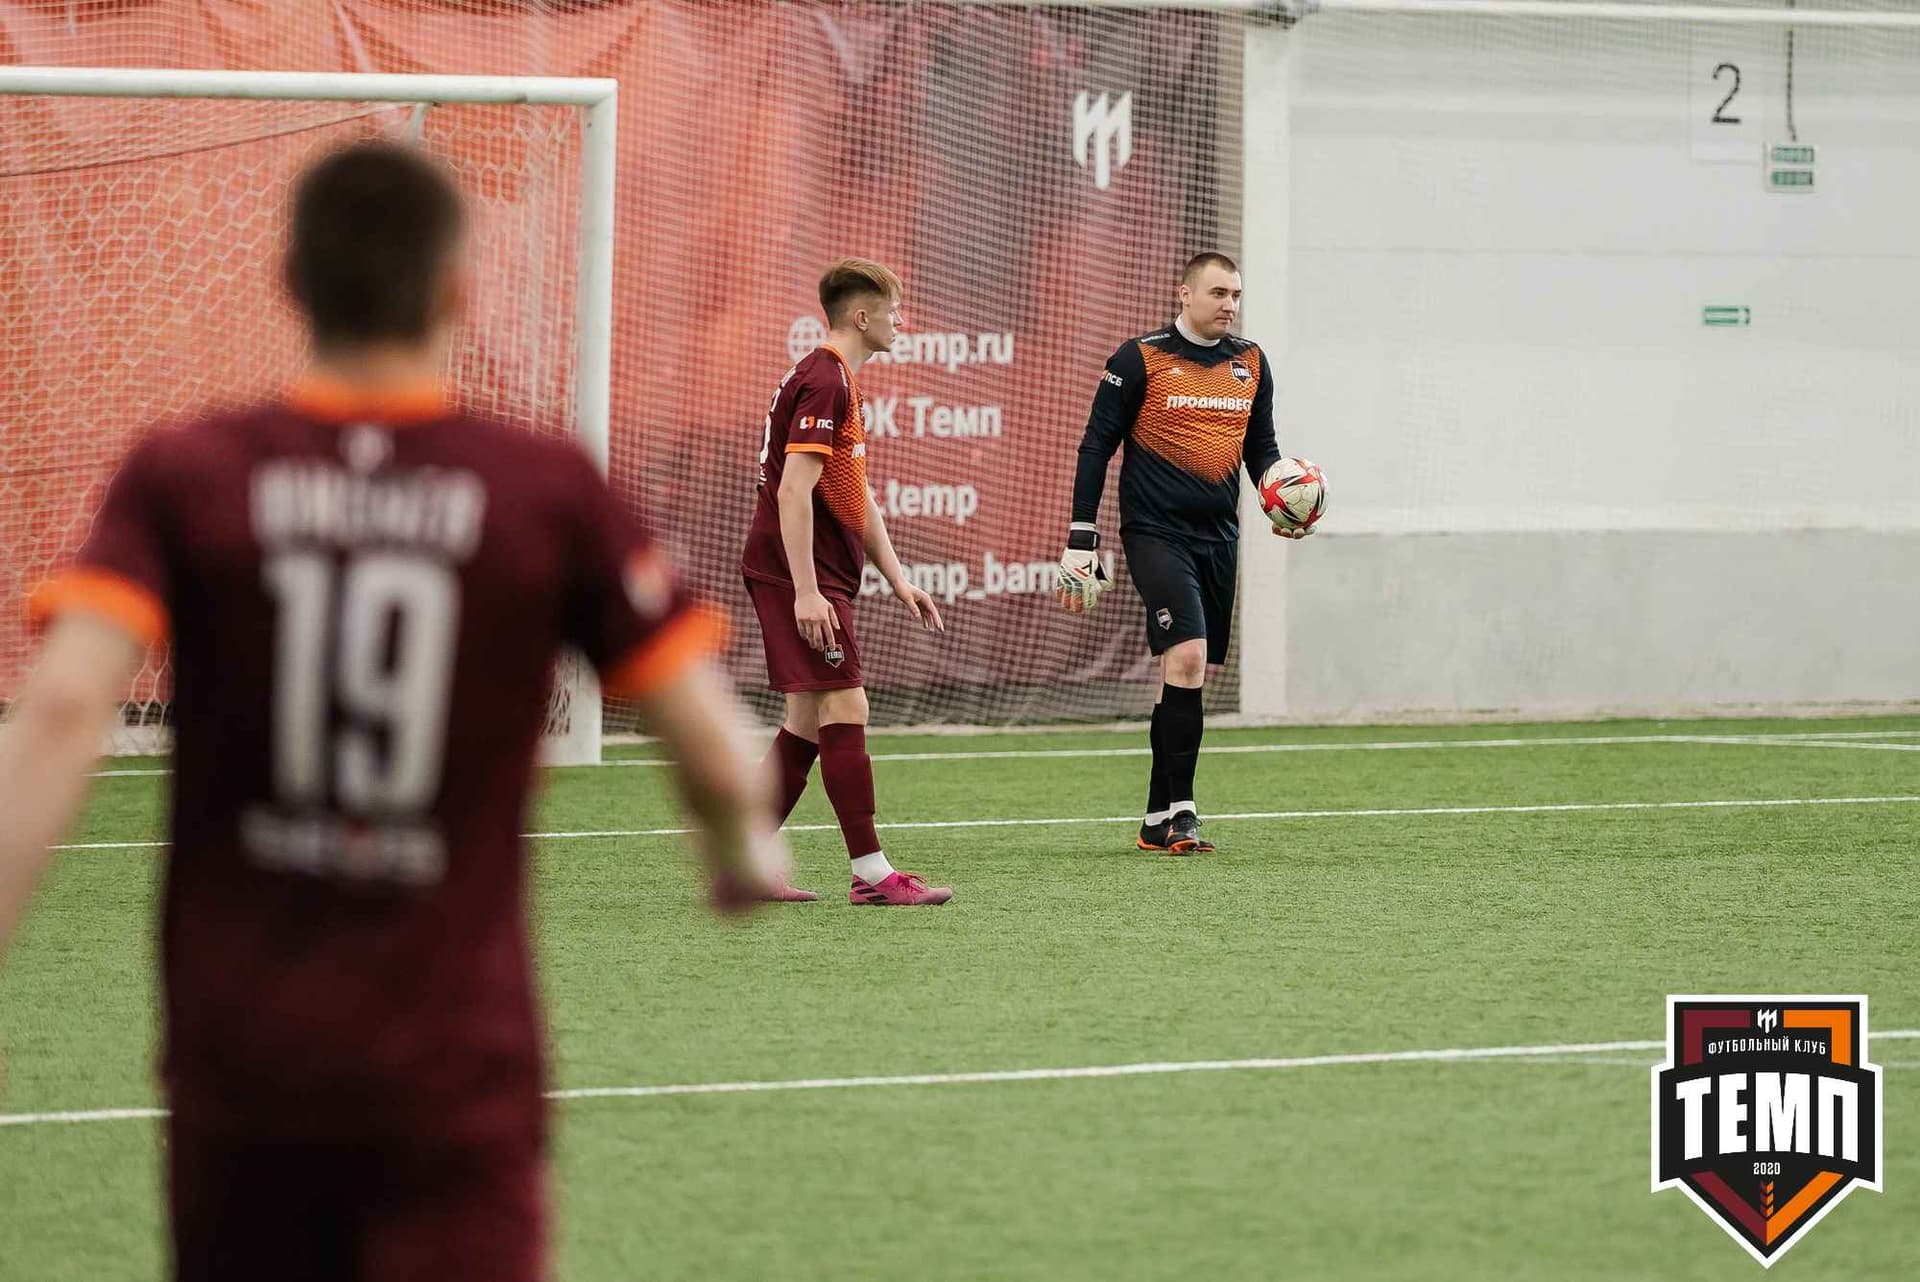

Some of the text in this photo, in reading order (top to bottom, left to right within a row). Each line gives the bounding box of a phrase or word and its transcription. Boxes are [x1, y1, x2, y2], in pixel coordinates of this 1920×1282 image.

[1711, 63, 1742, 124] 2
[1105, 372, 1124, 388] ПСБ
[816, 418, 834, 430] ПС
[908, 396, 1002, 438] Темп
[264, 551, 462, 813] 19
